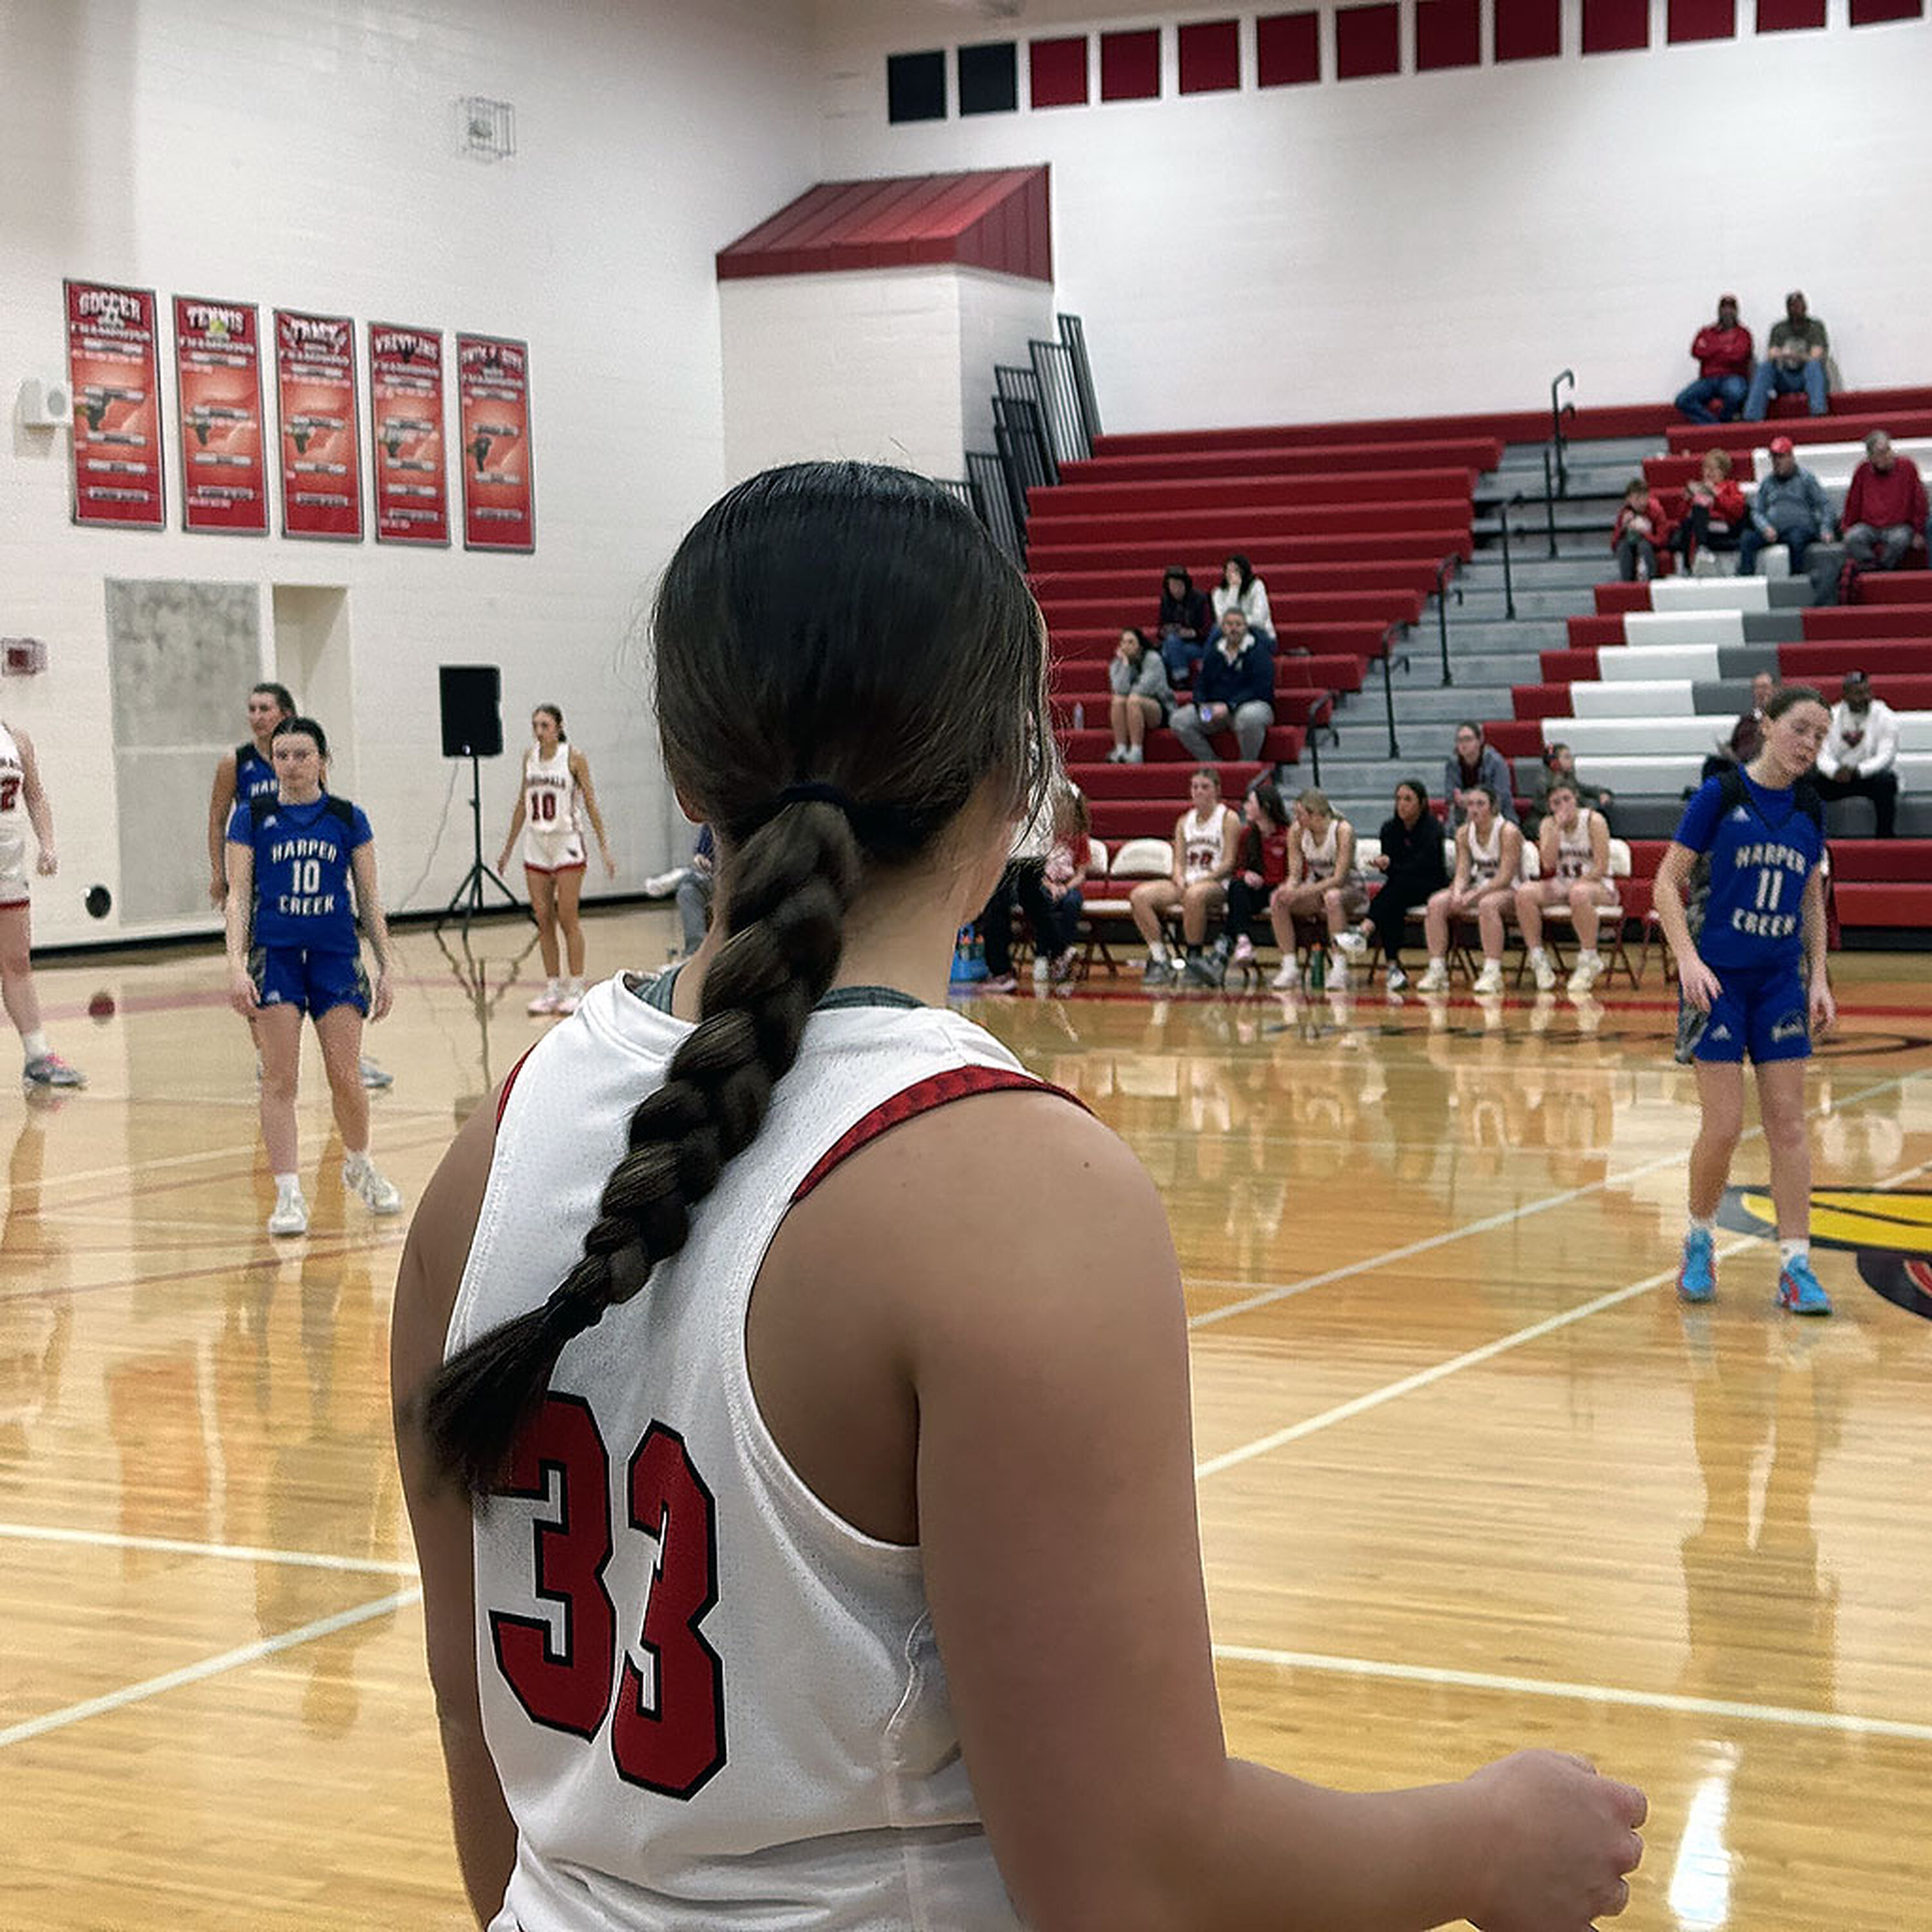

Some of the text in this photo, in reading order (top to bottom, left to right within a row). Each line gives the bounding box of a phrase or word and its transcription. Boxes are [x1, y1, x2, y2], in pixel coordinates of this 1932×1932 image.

[532, 791, 556, 822] 10
[272, 838, 336, 864] HARPER
[1735, 842, 1806, 875] HARPER
[293, 859, 320, 894] 10
[1756, 867, 1783, 910] 11
[279, 895, 334, 915] CREEK
[1732, 907, 1797, 937] CREEK
[488, 1390, 728, 1802] 33
